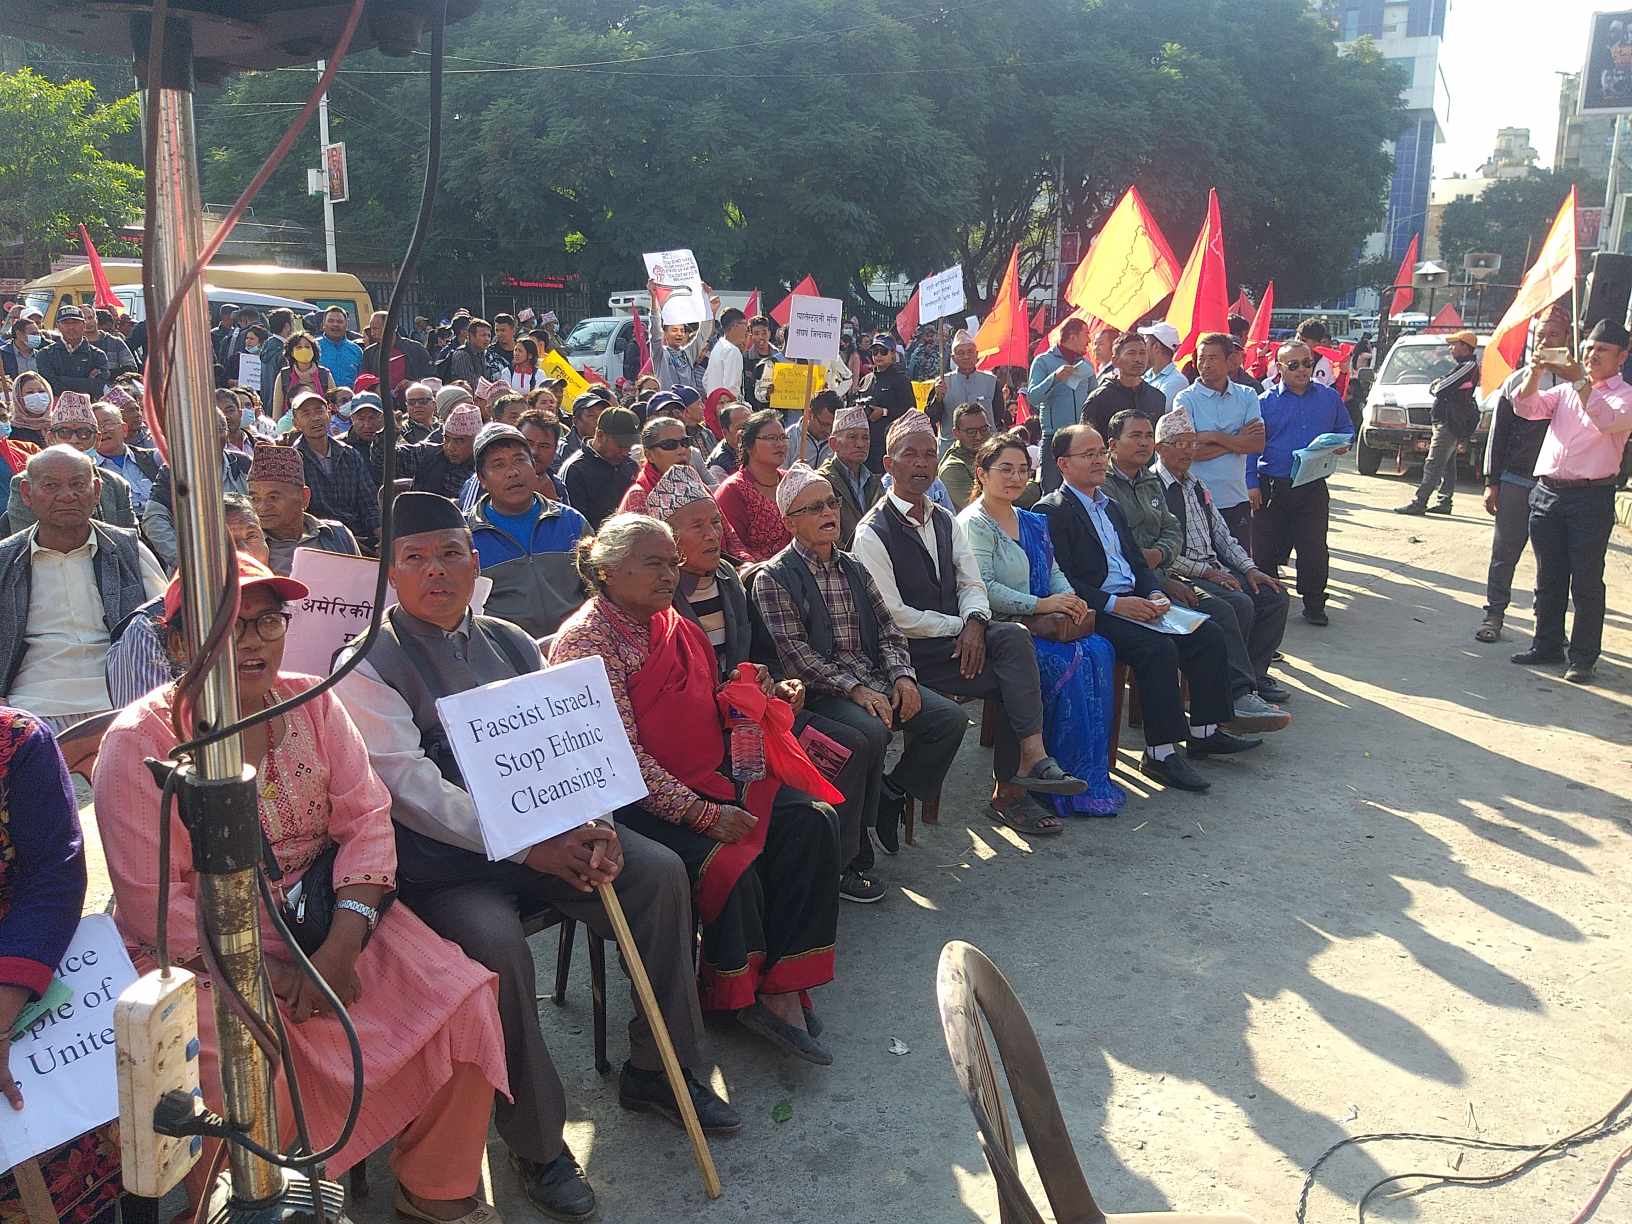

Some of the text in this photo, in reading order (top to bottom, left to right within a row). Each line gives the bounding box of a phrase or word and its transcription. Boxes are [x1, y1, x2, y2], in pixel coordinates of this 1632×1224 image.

[301, 596, 373, 619] अमेरिकी
[467, 684, 601, 744] Fascist Israel,
[494, 723, 604, 780] Stop Ethnic
[511, 765, 607, 814] Cleansing
[83, 976, 116, 1009] of
